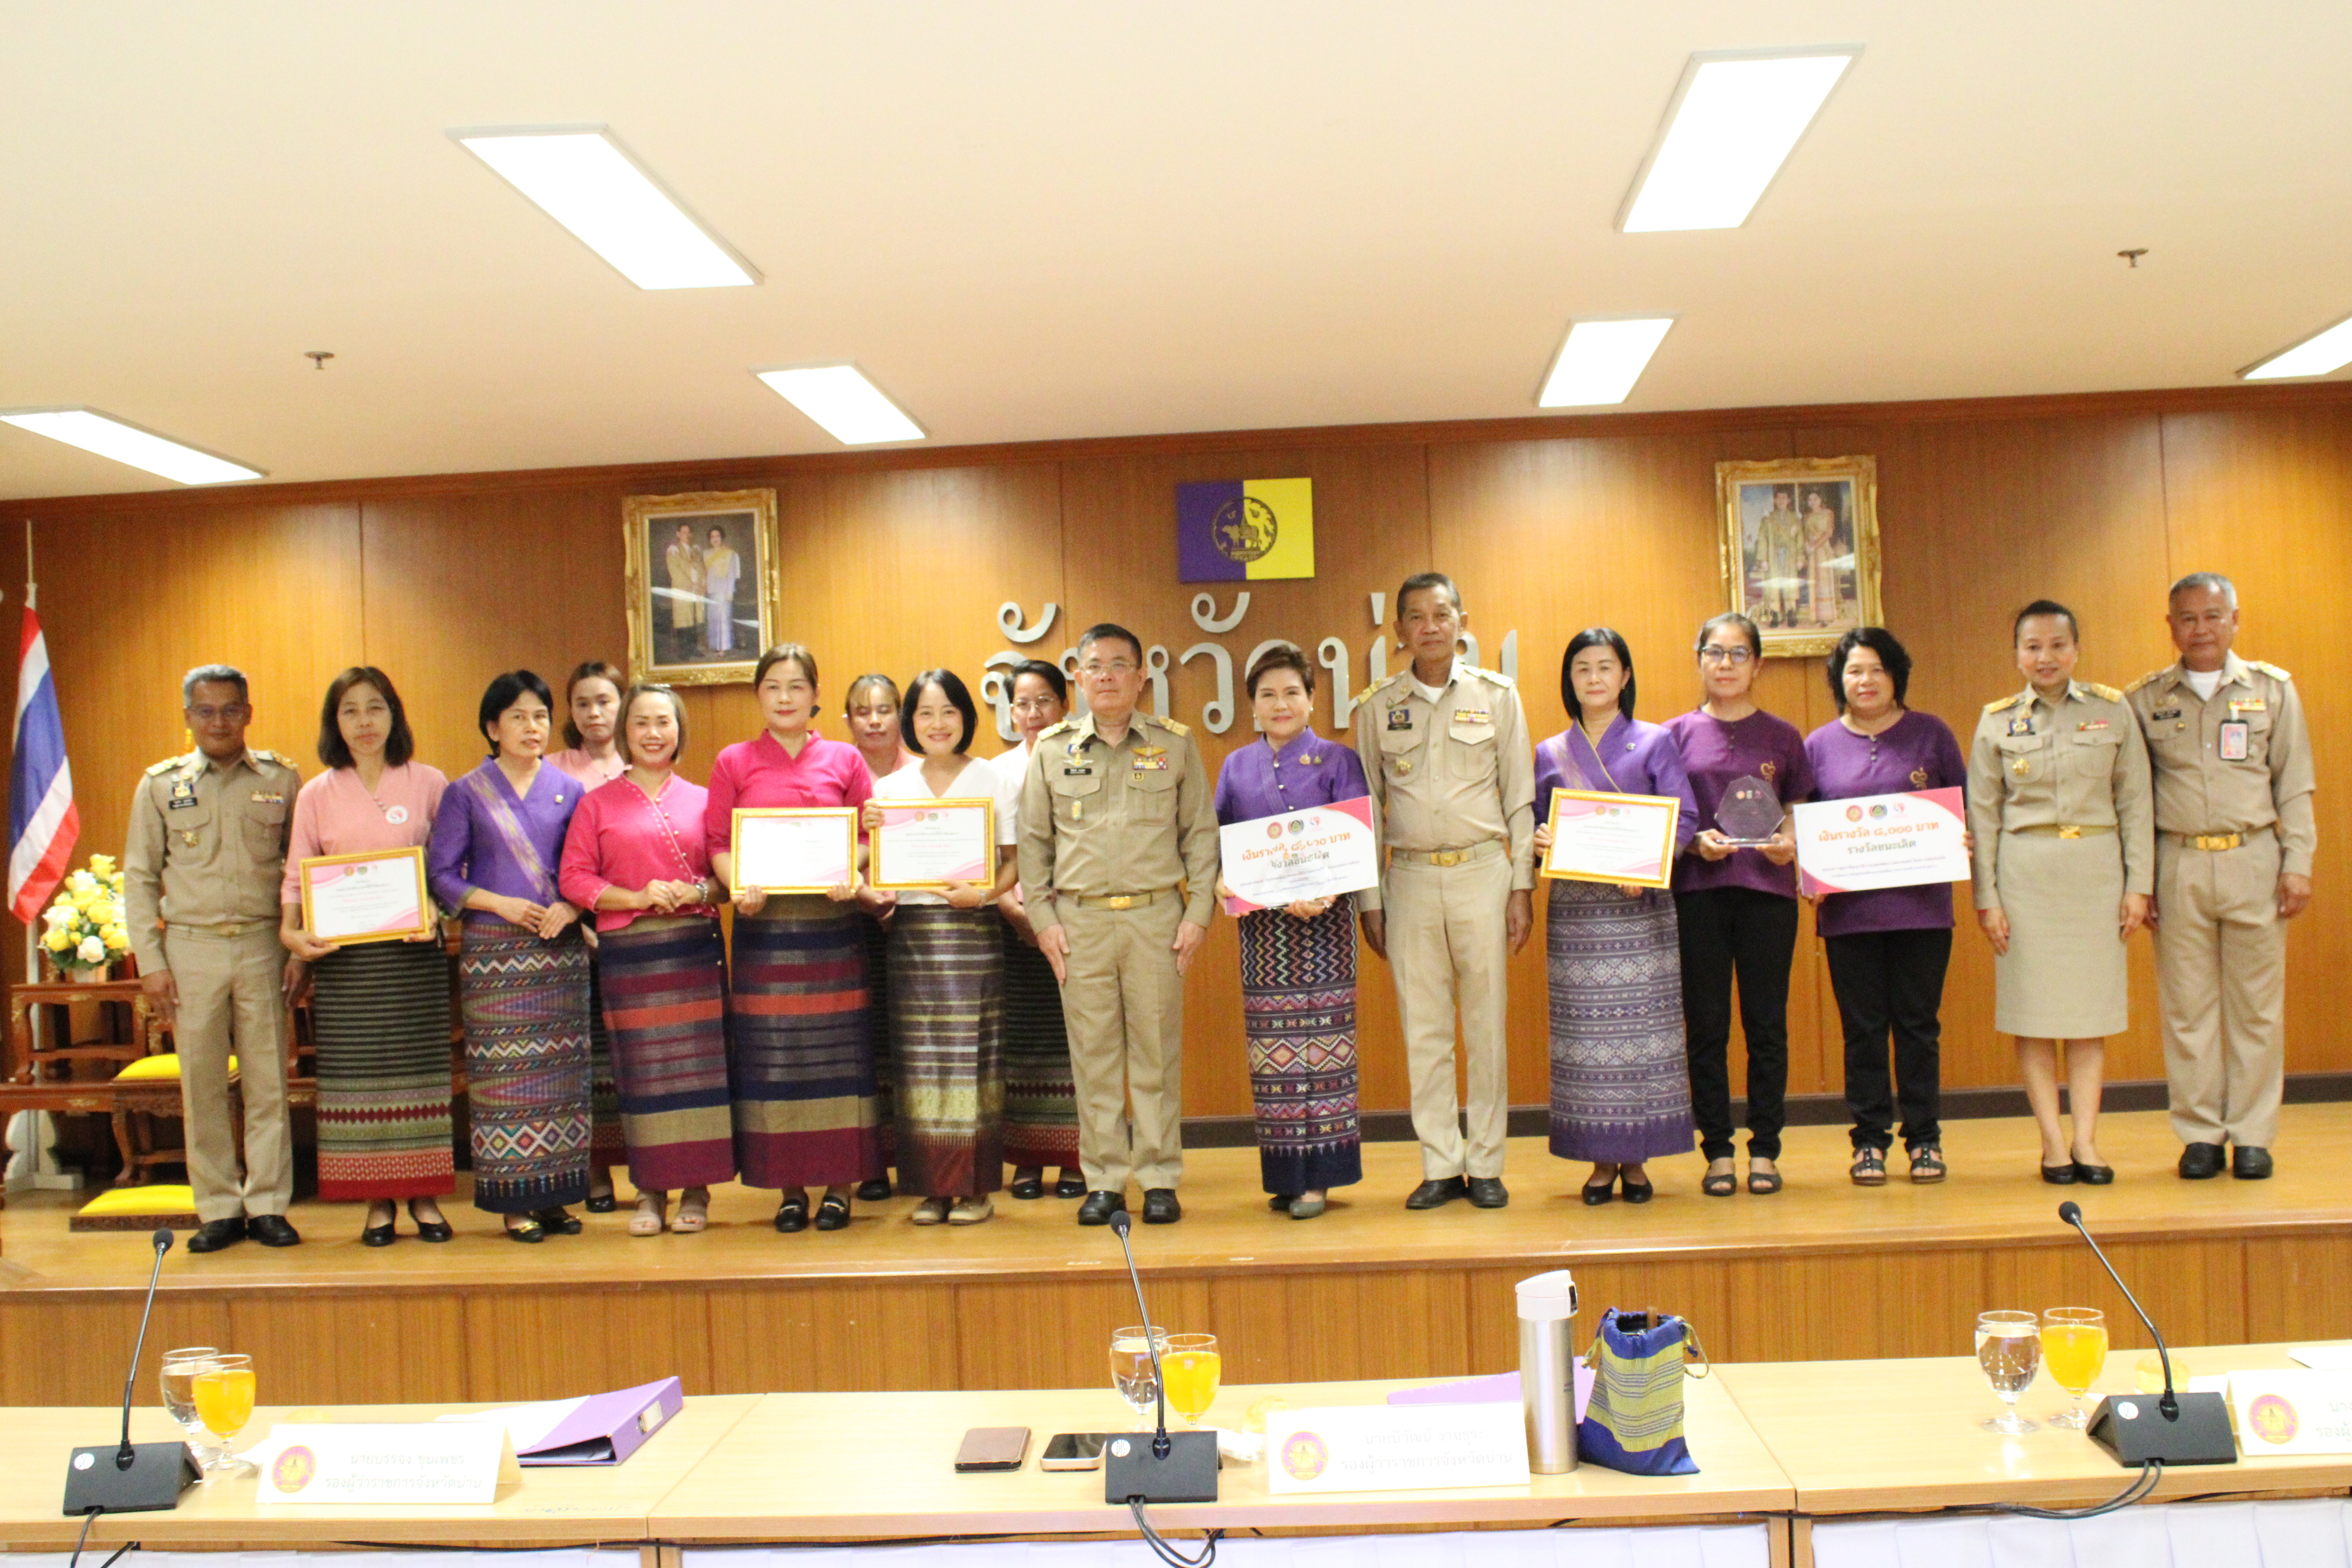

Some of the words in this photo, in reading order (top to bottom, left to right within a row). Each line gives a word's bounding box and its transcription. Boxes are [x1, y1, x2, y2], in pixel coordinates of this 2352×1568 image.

[1329, 832, 1351, 844] บาท
[1818, 827, 1870, 842] เงินรางวัล
[1915, 821, 1939, 832] บาท
[1847, 839, 1916, 854] รางวัลชนะเลิศ
[1364, 1427, 1432, 1445] นายนิวัฒน์
[1438, 1429, 1485, 1446] งามธุระ
[351, 1454, 412, 1465] นายบรรจง
[417, 1454, 465, 1469] ขุนเพชร
[1341, 1449, 1513, 1475] รองผู้ว่าราชการจังหวัดน่าน
[325, 1473, 482, 1494] รองผู้ว่าราชการจังหวัดน่าน
